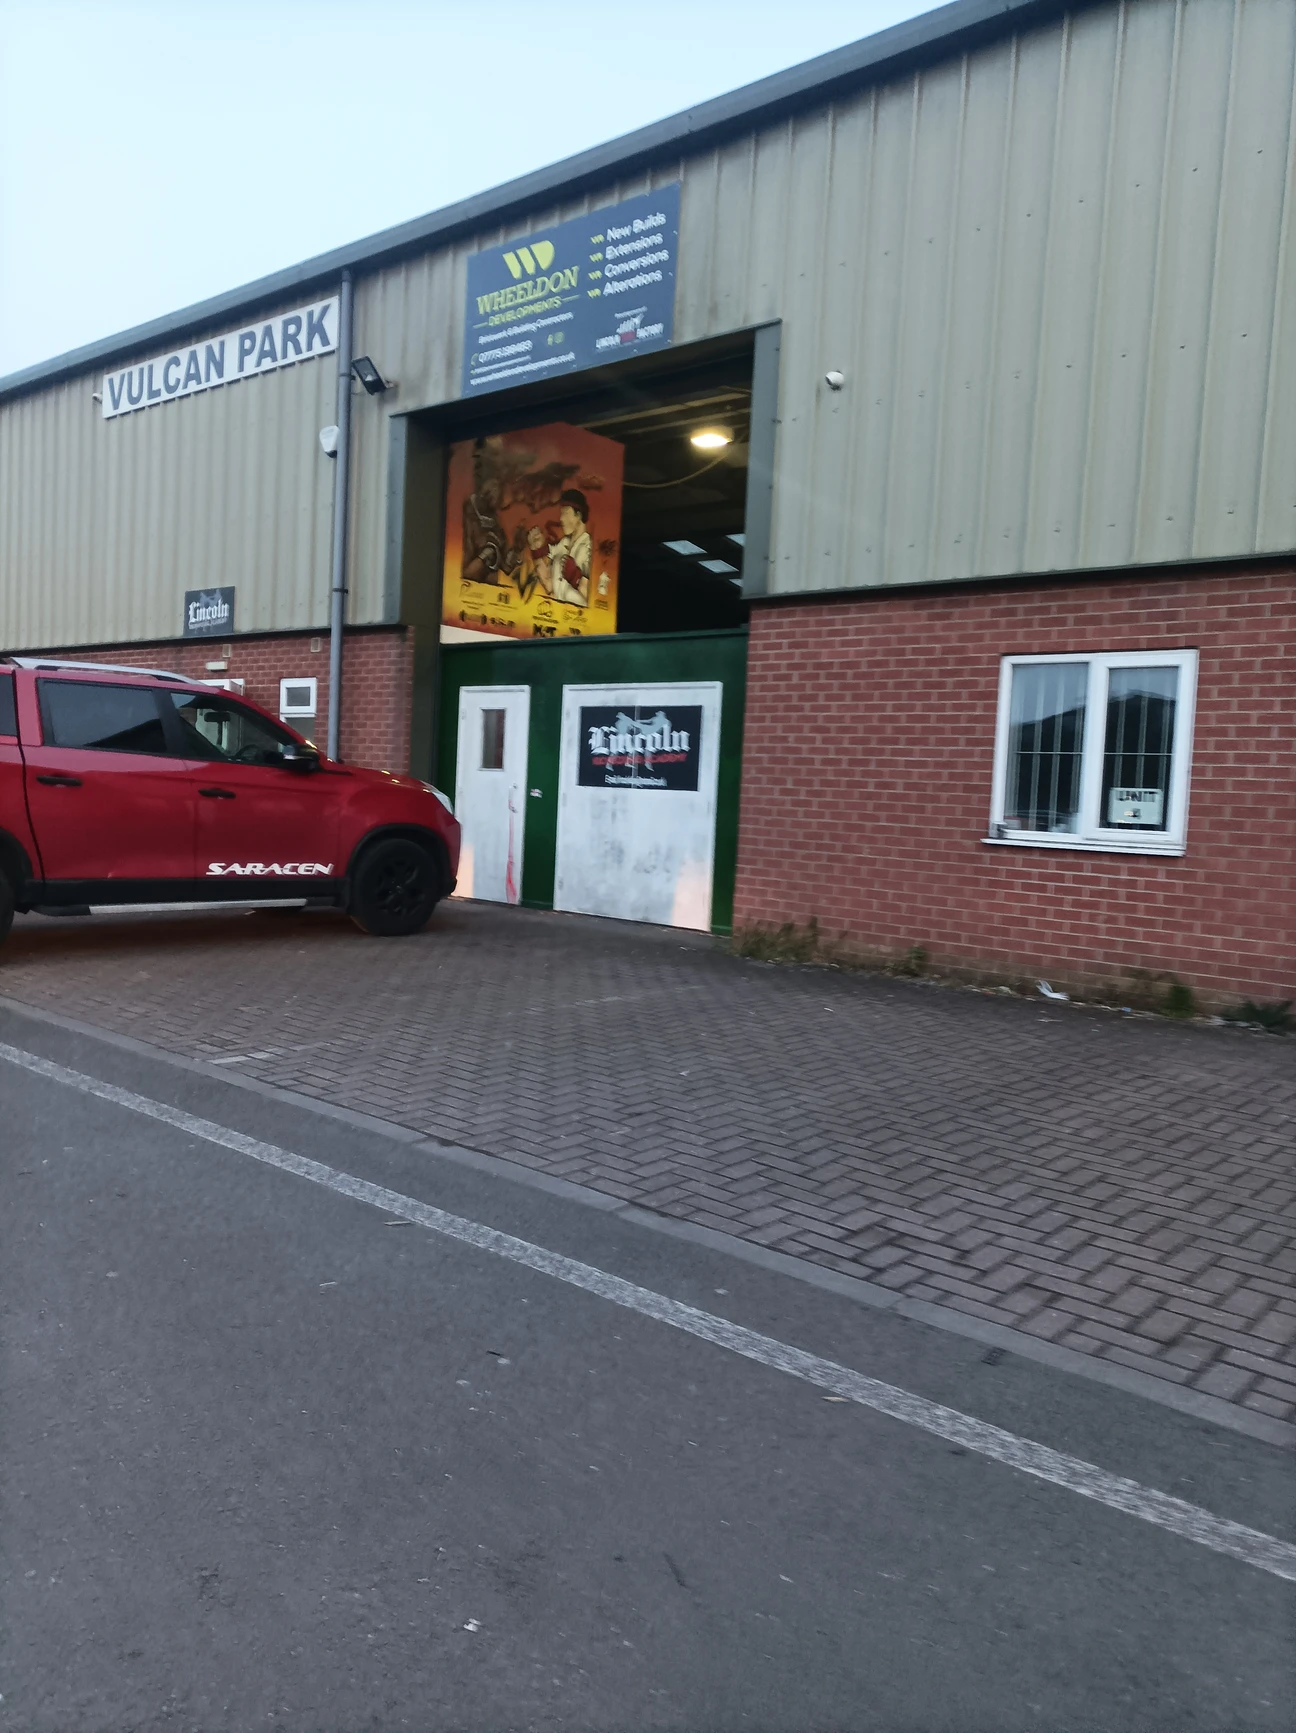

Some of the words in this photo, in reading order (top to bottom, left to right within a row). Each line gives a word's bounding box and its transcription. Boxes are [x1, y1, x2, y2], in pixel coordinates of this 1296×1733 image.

[606, 225, 632, 242] New
[632, 212, 666, 234] Builds
[605, 233, 663, 260] Extensions
[604, 249, 669, 278] Conversions
[476, 266, 580, 315] WHEELDON
[603, 270, 663, 296] Alterations
[489, 296, 562, 326] DEVELOPMENTS
[107, 339, 225, 411] VULCAN
[237, 303, 331, 373] PARK
[188, 598, 230, 623] Lincoln
[588, 724, 691, 755] Lincoln
[205, 862, 334, 876] SARACEN
